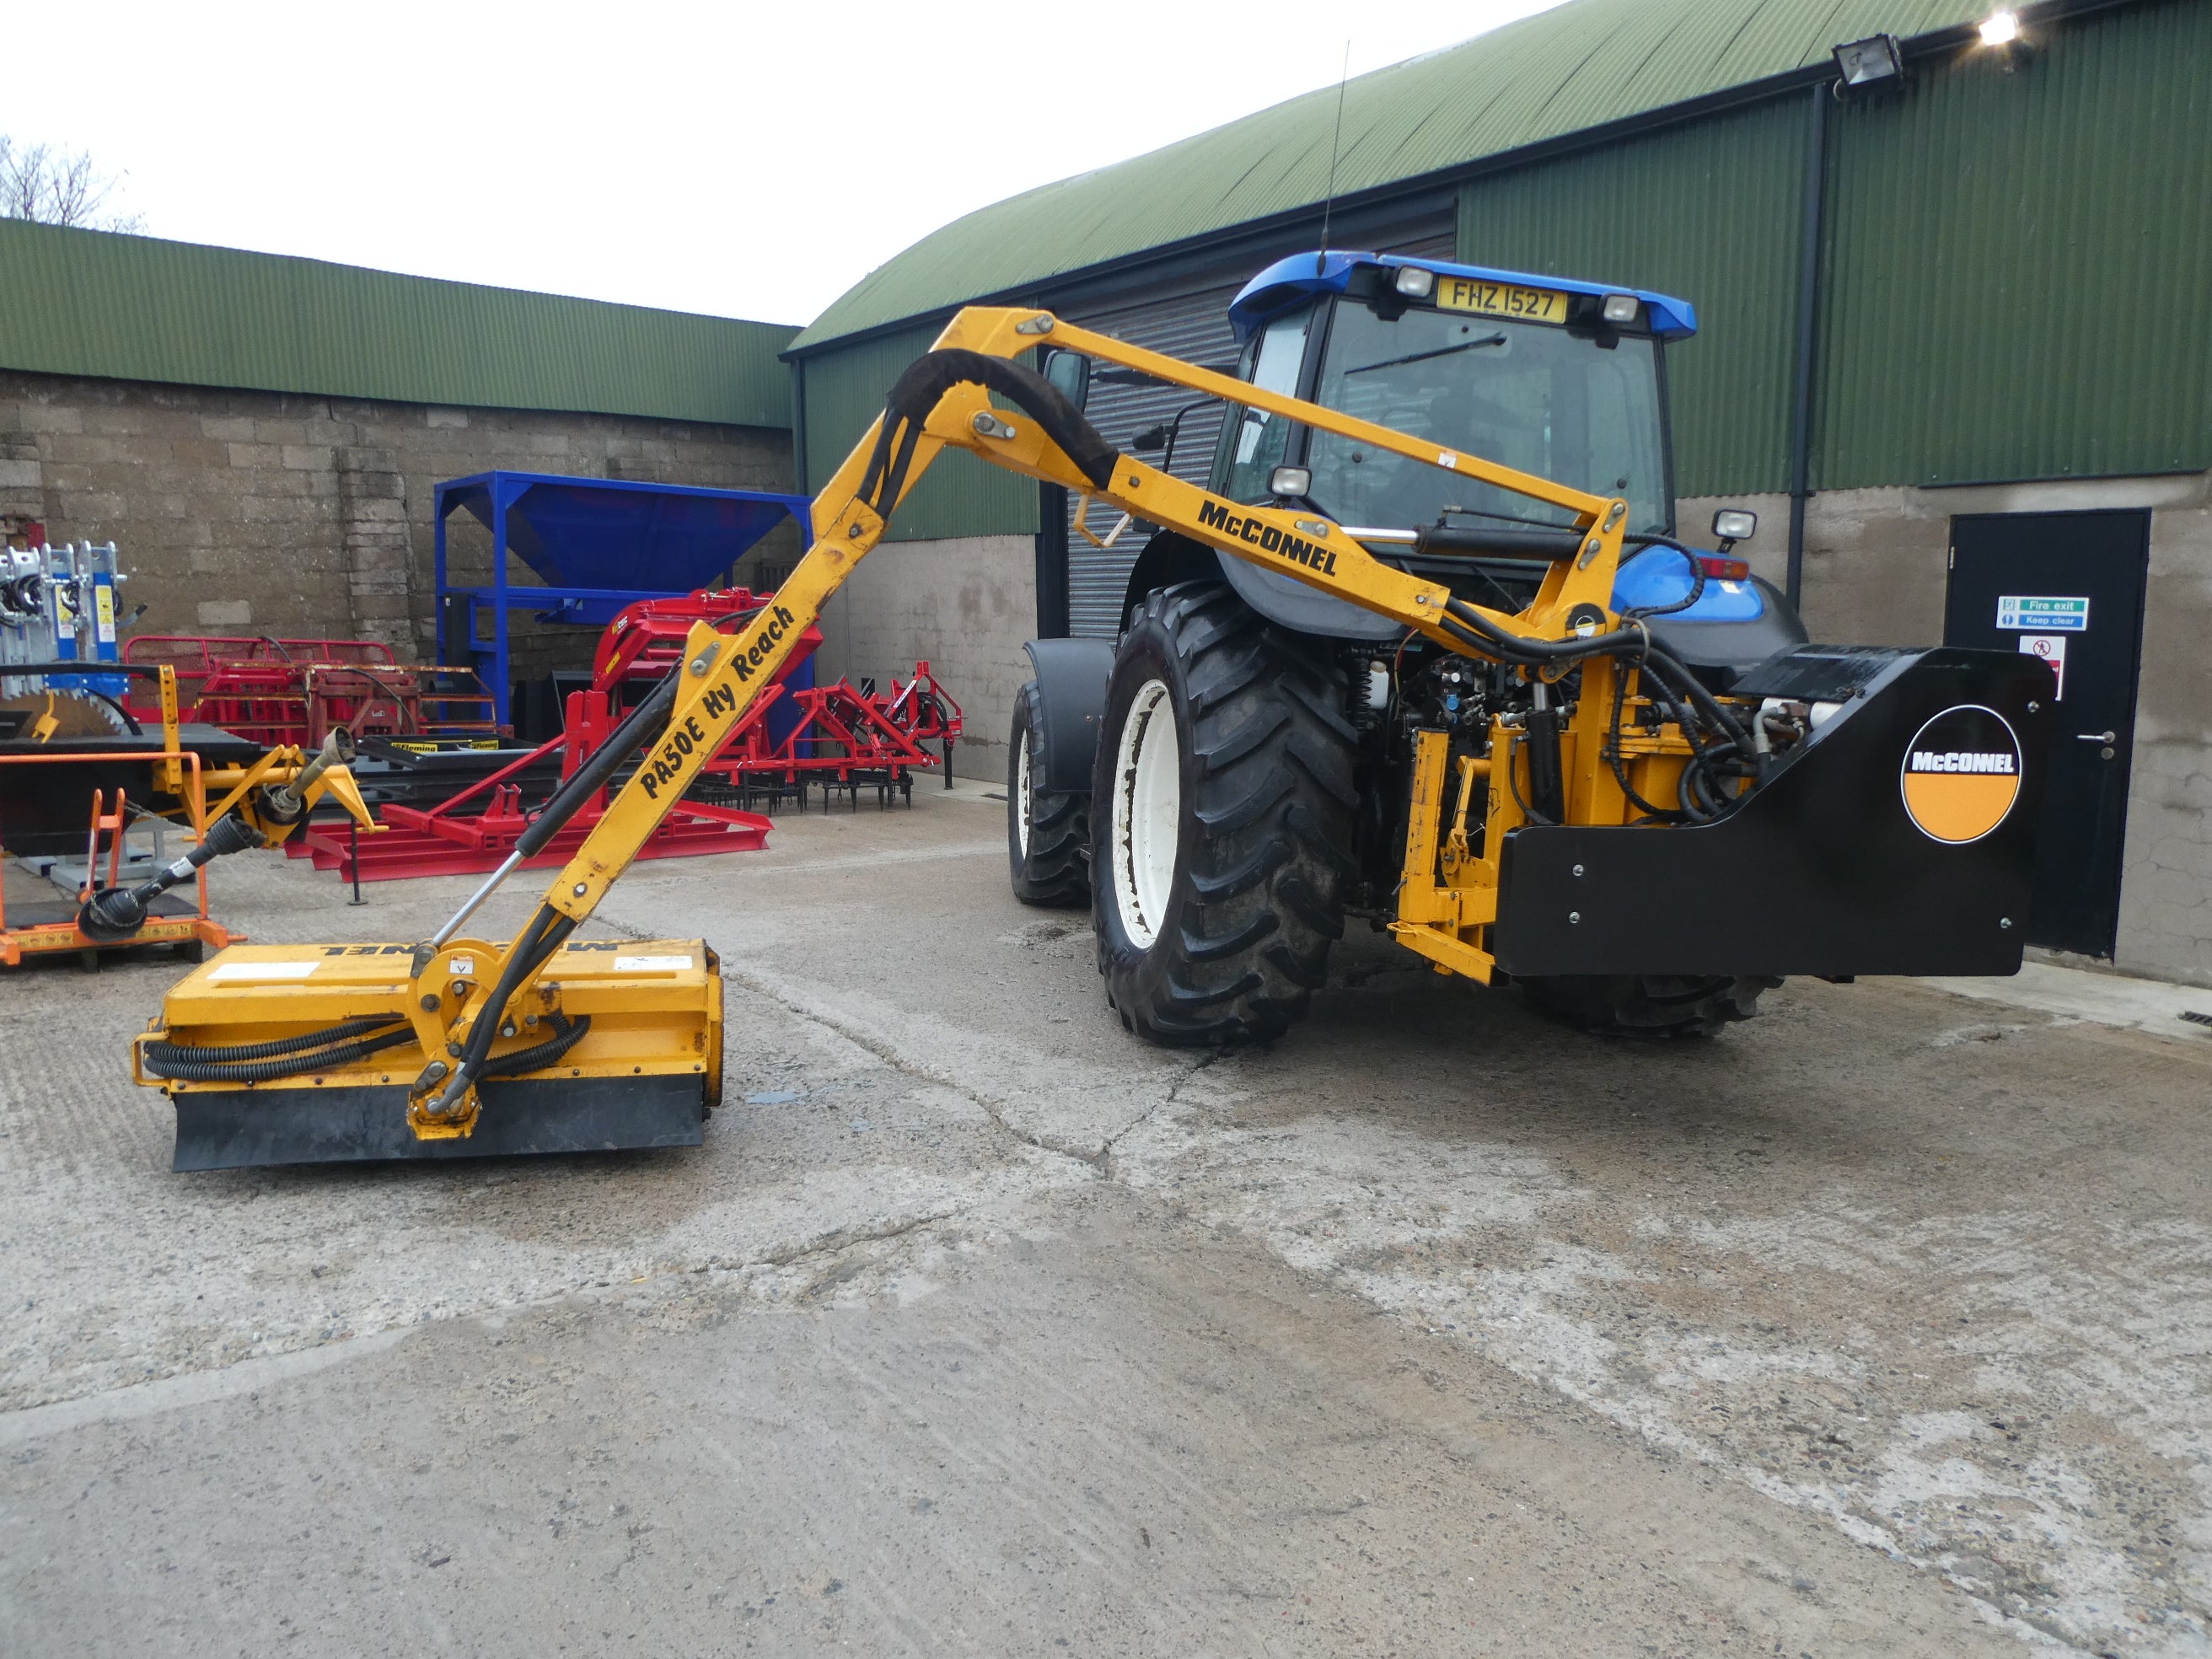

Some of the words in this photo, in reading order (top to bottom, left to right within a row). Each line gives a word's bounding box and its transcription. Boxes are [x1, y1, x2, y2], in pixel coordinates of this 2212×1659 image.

[1453, 282, 1498, 309] FHZ
[1504, 287, 1554, 316] 1527
[1197, 499, 1337, 577] McCONNEL
[2029, 600, 2049, 610] Fire
[2054, 602, 2074, 610] exit
[2026, 615, 2048, 625] Keep
[2052, 616, 2075, 625] clear
[701, 683, 736, 719] Hy
[731, 605, 795, 681] Reach
[401, 743, 436, 752] Fleming
[1911, 751, 2015, 773] McCONNEL
